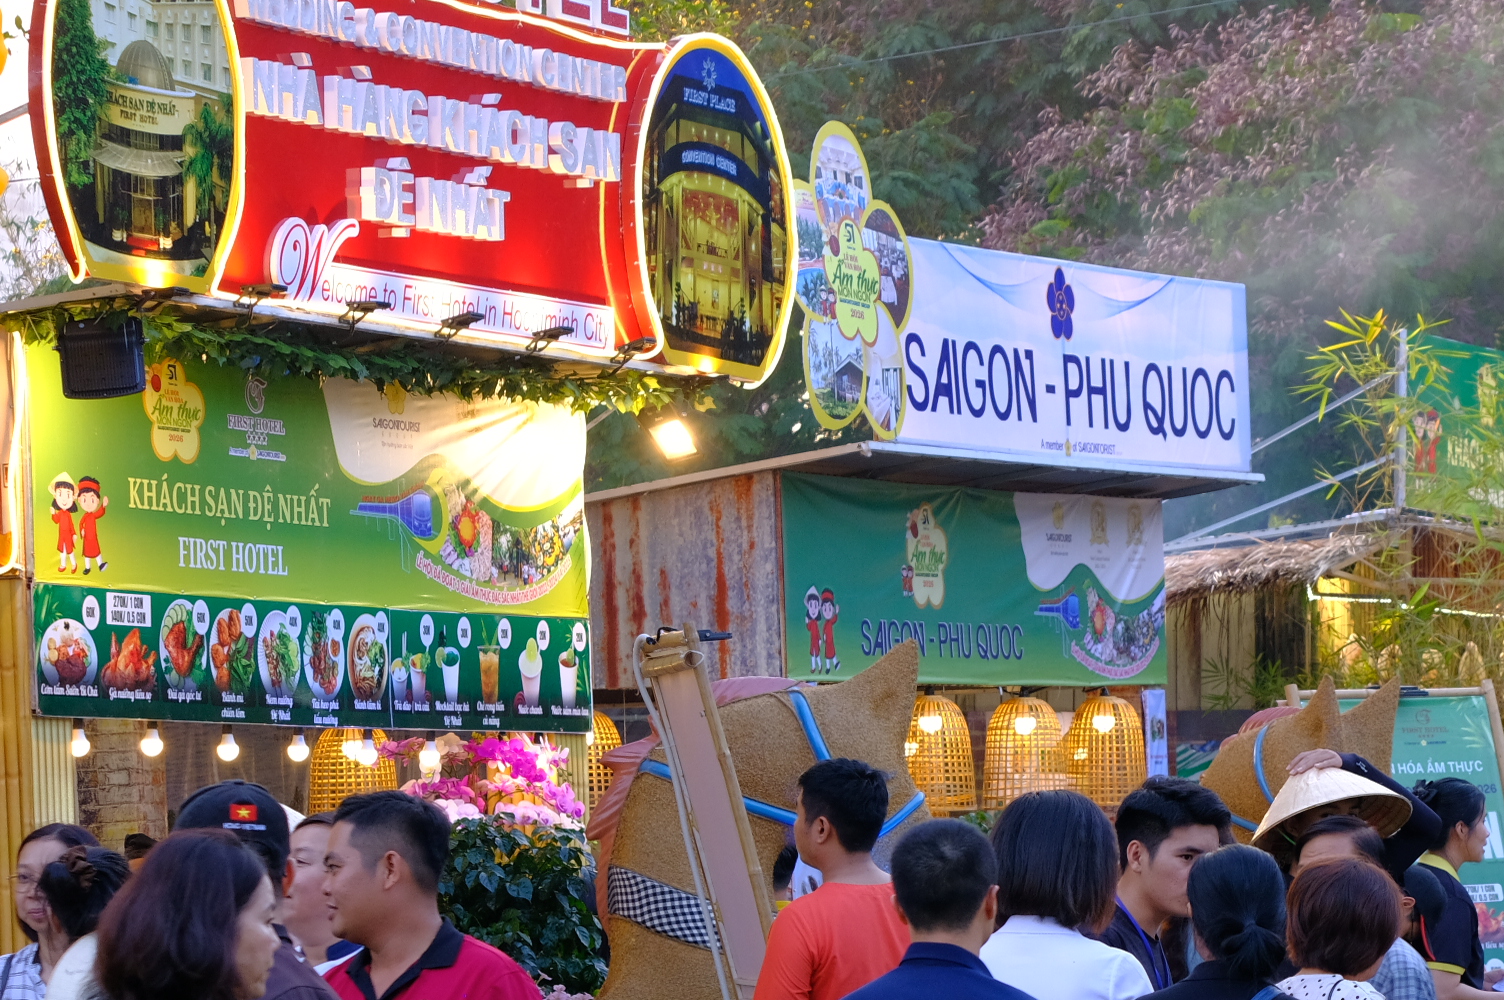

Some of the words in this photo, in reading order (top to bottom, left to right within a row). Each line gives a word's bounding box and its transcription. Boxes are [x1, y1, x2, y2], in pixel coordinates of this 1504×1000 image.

[357, 8, 381, 48] &
[374, 12, 532, 84] CONVENTION
[532, 48, 627, 102] CENTER
[683, 87, 709, 106] FIRST
[709, 93, 736, 113] PLACE
[120, 109, 137, 121] FIRST
[139, 114, 158, 125] HOTEL
[241, 52, 323, 126] NHÀ
[324, 65, 428, 147] HÀNG
[428, 93, 548, 169] KHÁCH
[548, 120, 621, 188] SẠN
[682, 150, 715, 167] CONVENTION
[716, 154, 738, 176] CENTER
[360, 157, 416, 238] ĐỆ
[416, 166, 511, 241] NHẤT
[276, 220, 378, 303] Welcome
[383, 282, 397, 311] to
[484, 306, 498, 327] in
[583, 312, 610, 343] City
[904, 332, 1038, 424] SAIGON
[1062, 353, 1132, 433] PHU
[1142, 362, 1236, 442] QUOC
[227, 414, 254, 430] FIRST
[255, 417, 285, 435] HOTEL
[372, 417, 421, 433] SAIGONTOURIST
[168, 433, 184, 443] 2026
[128, 473, 201, 515] KHÁCH
[205, 486, 244, 527] SẠN
[248, 484, 274, 531] ĐỆ
[278, 483, 331, 527] NHẤT
[178, 536, 227, 570] FIRST
[230, 541, 288, 576] HOTEL
[86, 607, 96, 618] 60K
[196, 612, 206, 624] 60K
[244, 615, 254, 627] 50K
[861, 618, 926, 657] SAIGON
[938, 622, 973, 659] PHU
[977, 623, 1024, 661] QUOC
[1397, 759, 1424, 775] HÓA
[1427, 757, 1446, 774] ẨM
[1447, 760, 1484, 775] THỰC
